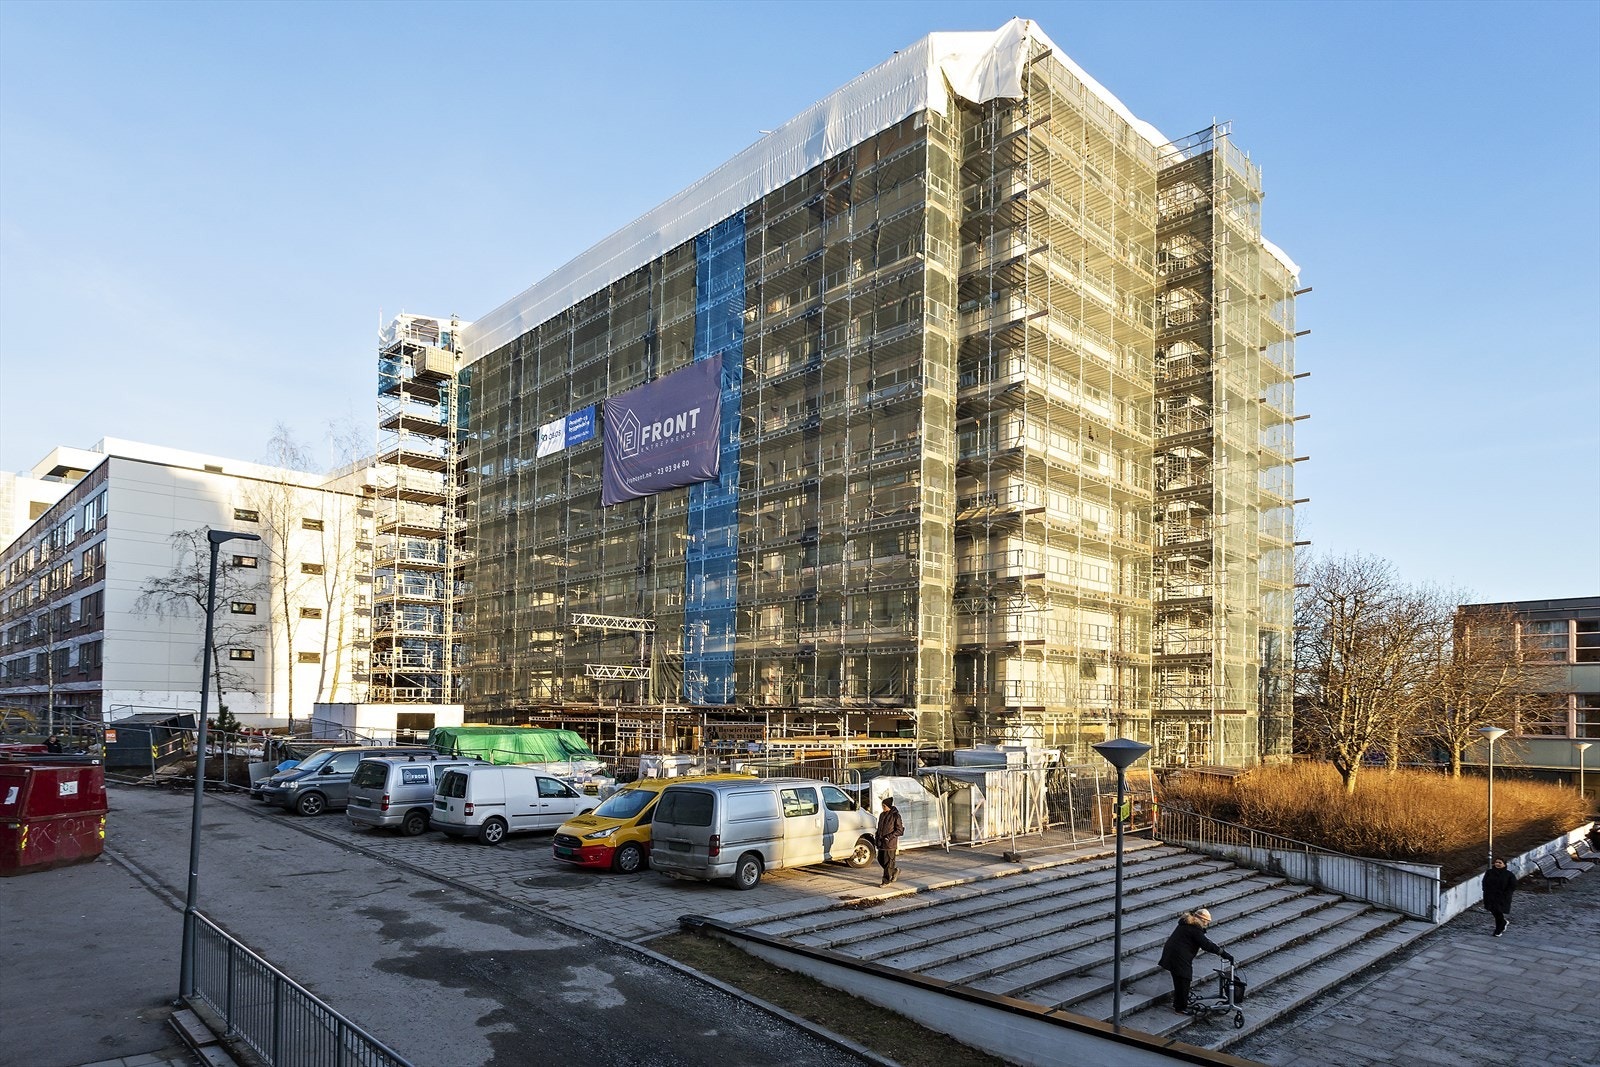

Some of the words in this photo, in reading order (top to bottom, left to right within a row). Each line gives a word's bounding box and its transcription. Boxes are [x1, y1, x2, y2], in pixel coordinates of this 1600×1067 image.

[641, 407, 701, 446] FRONT
[657, 467, 664, 475] 23
[665, 465, 672, 473] 03
[681, 459, 690, 468] 80
